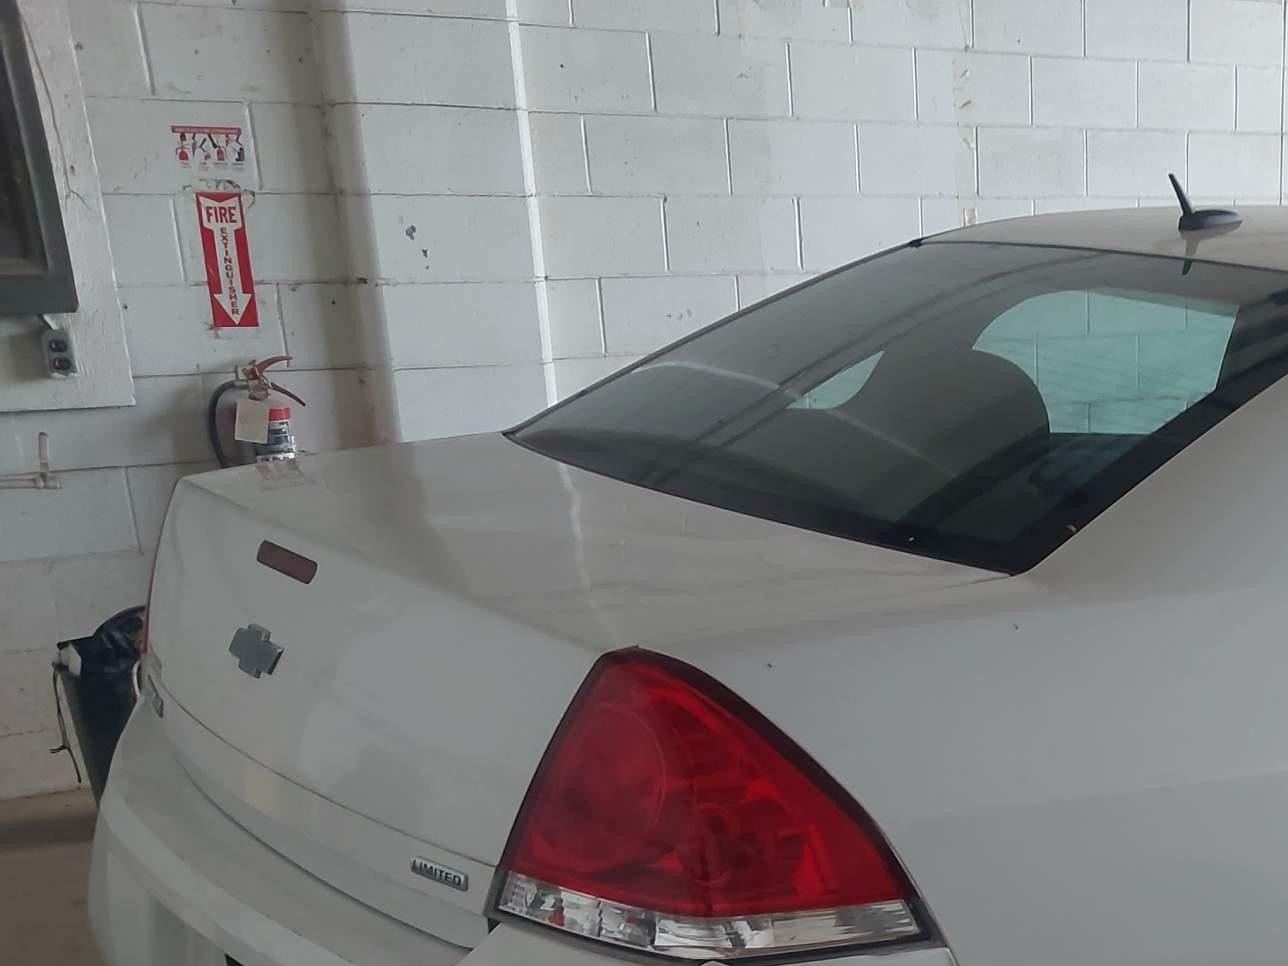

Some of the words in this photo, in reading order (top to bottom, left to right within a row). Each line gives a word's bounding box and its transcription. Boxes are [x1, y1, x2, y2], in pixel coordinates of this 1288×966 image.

[205, 206, 238, 223] FIRE
[219, 227, 240, 315] EXTINGUISHER
[411, 859, 463, 887] LIMITED
